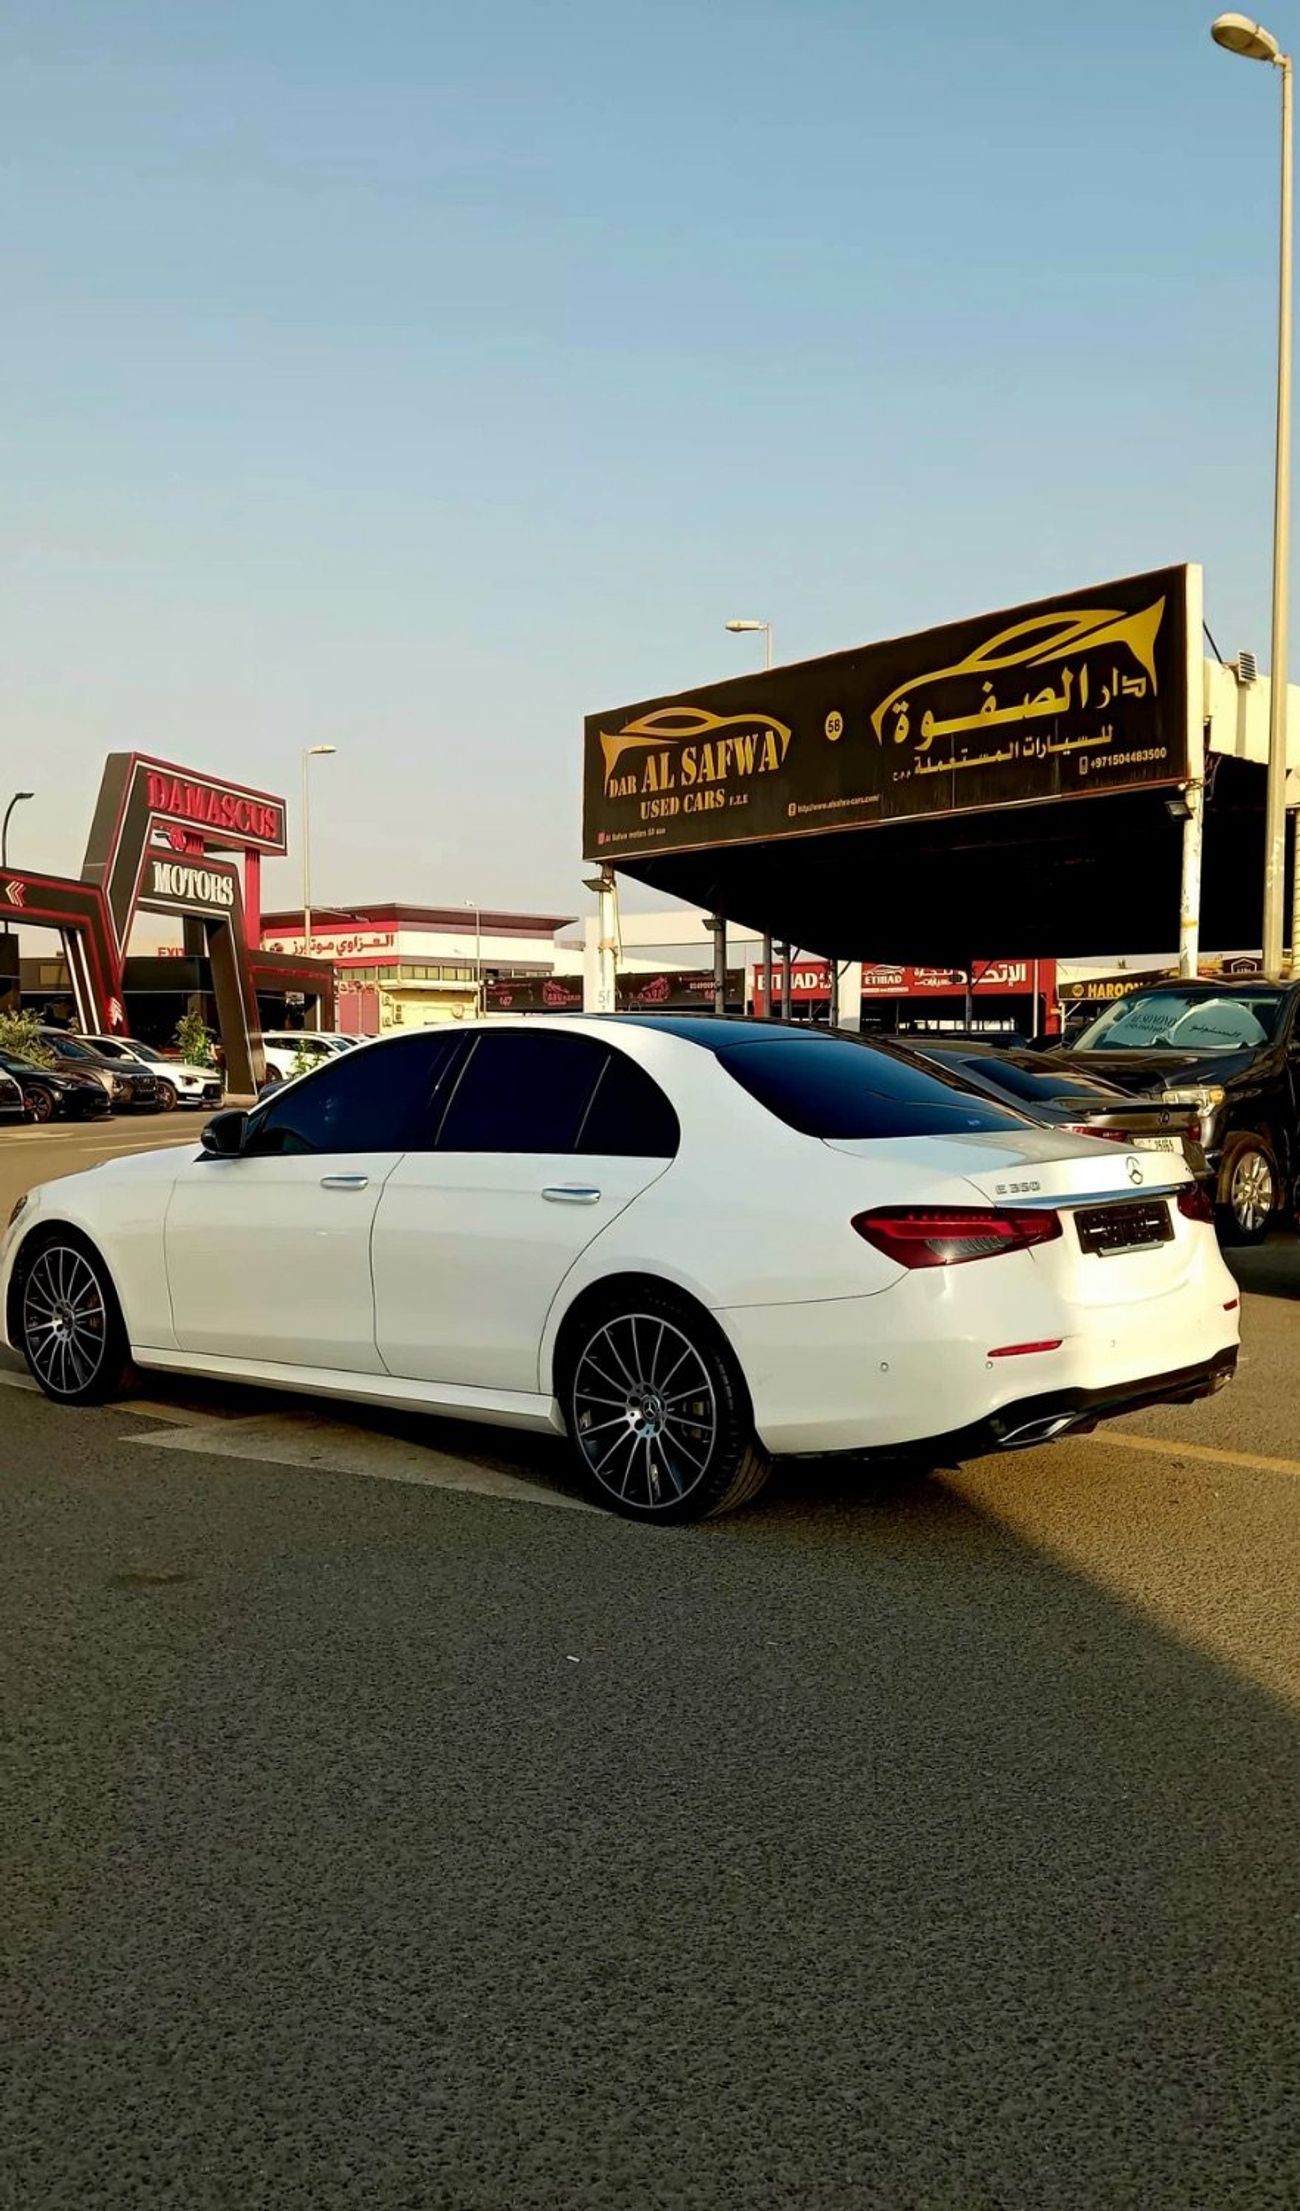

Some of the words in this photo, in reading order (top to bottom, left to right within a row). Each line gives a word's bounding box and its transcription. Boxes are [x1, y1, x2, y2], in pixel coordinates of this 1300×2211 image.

[892, 662, 1088, 751] الصفوة
[1097, 667, 1147, 709] دار
[827, 717, 842, 734] 58
[1022, 724, 1113, 758] للسيارات
[609, 776, 637, 799] DAR
[641, 751, 675, 794] AL
[681, 730, 780, 786] SAFWA
[914, 741, 1020, 775] المستعملة
[147, 773, 278, 839] DAMASCUS
[640, 797, 680, 820] USED
[683, 789, 725, 813] CARS
[152, 860, 234, 905] MOTORS
[995, 1183, 1008, 1195] E
[1009, 1180, 1041, 1193] 350
